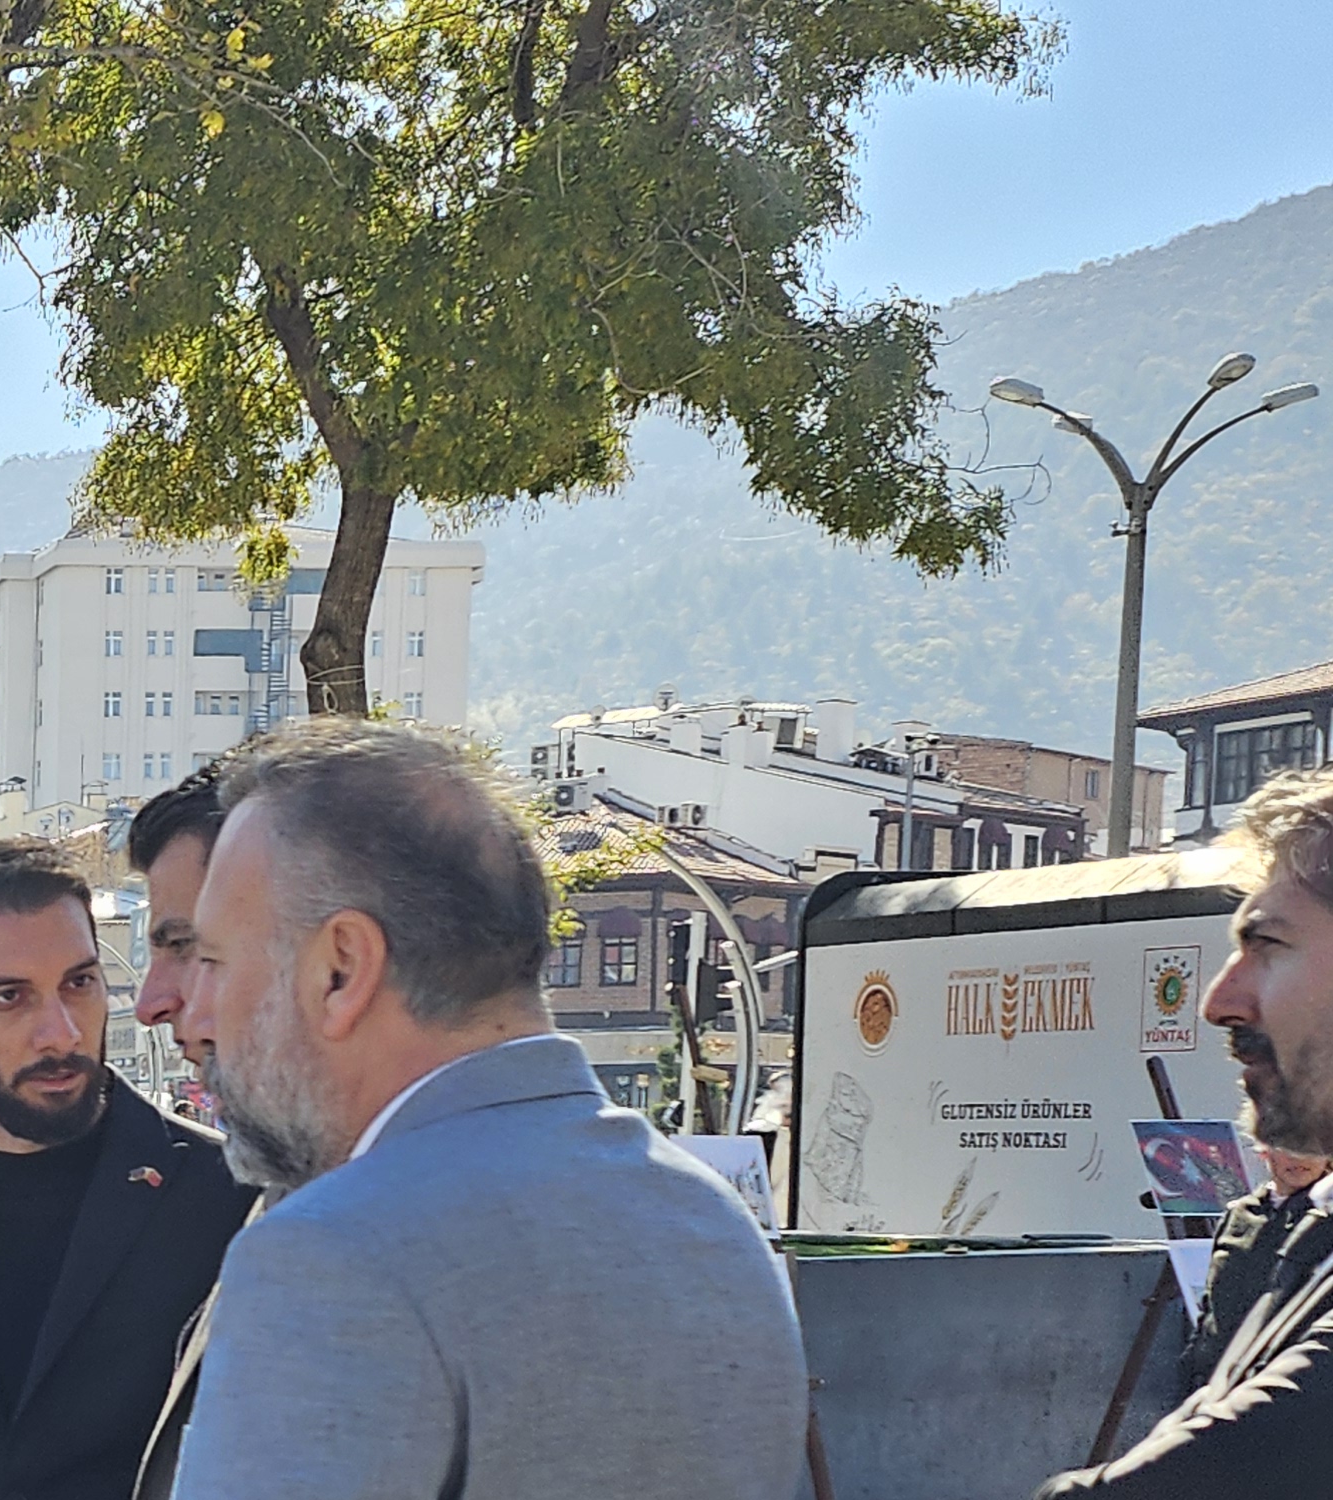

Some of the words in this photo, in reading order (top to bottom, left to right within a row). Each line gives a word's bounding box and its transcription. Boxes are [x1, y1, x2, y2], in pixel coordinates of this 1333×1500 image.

[946, 981, 999, 1035] HALK
[1022, 976, 1096, 1033] EKMEK
[1146, 1027, 1190, 1043] YÜNTAŞ
[941, 1099, 1017, 1119] GLUTENSİZ
[1021, 1098, 1092, 1119] ÜRÜNLER
[959, 1132, 999, 1152] SATIŞ
[1001, 1132, 1067, 1148] NOKTASI
